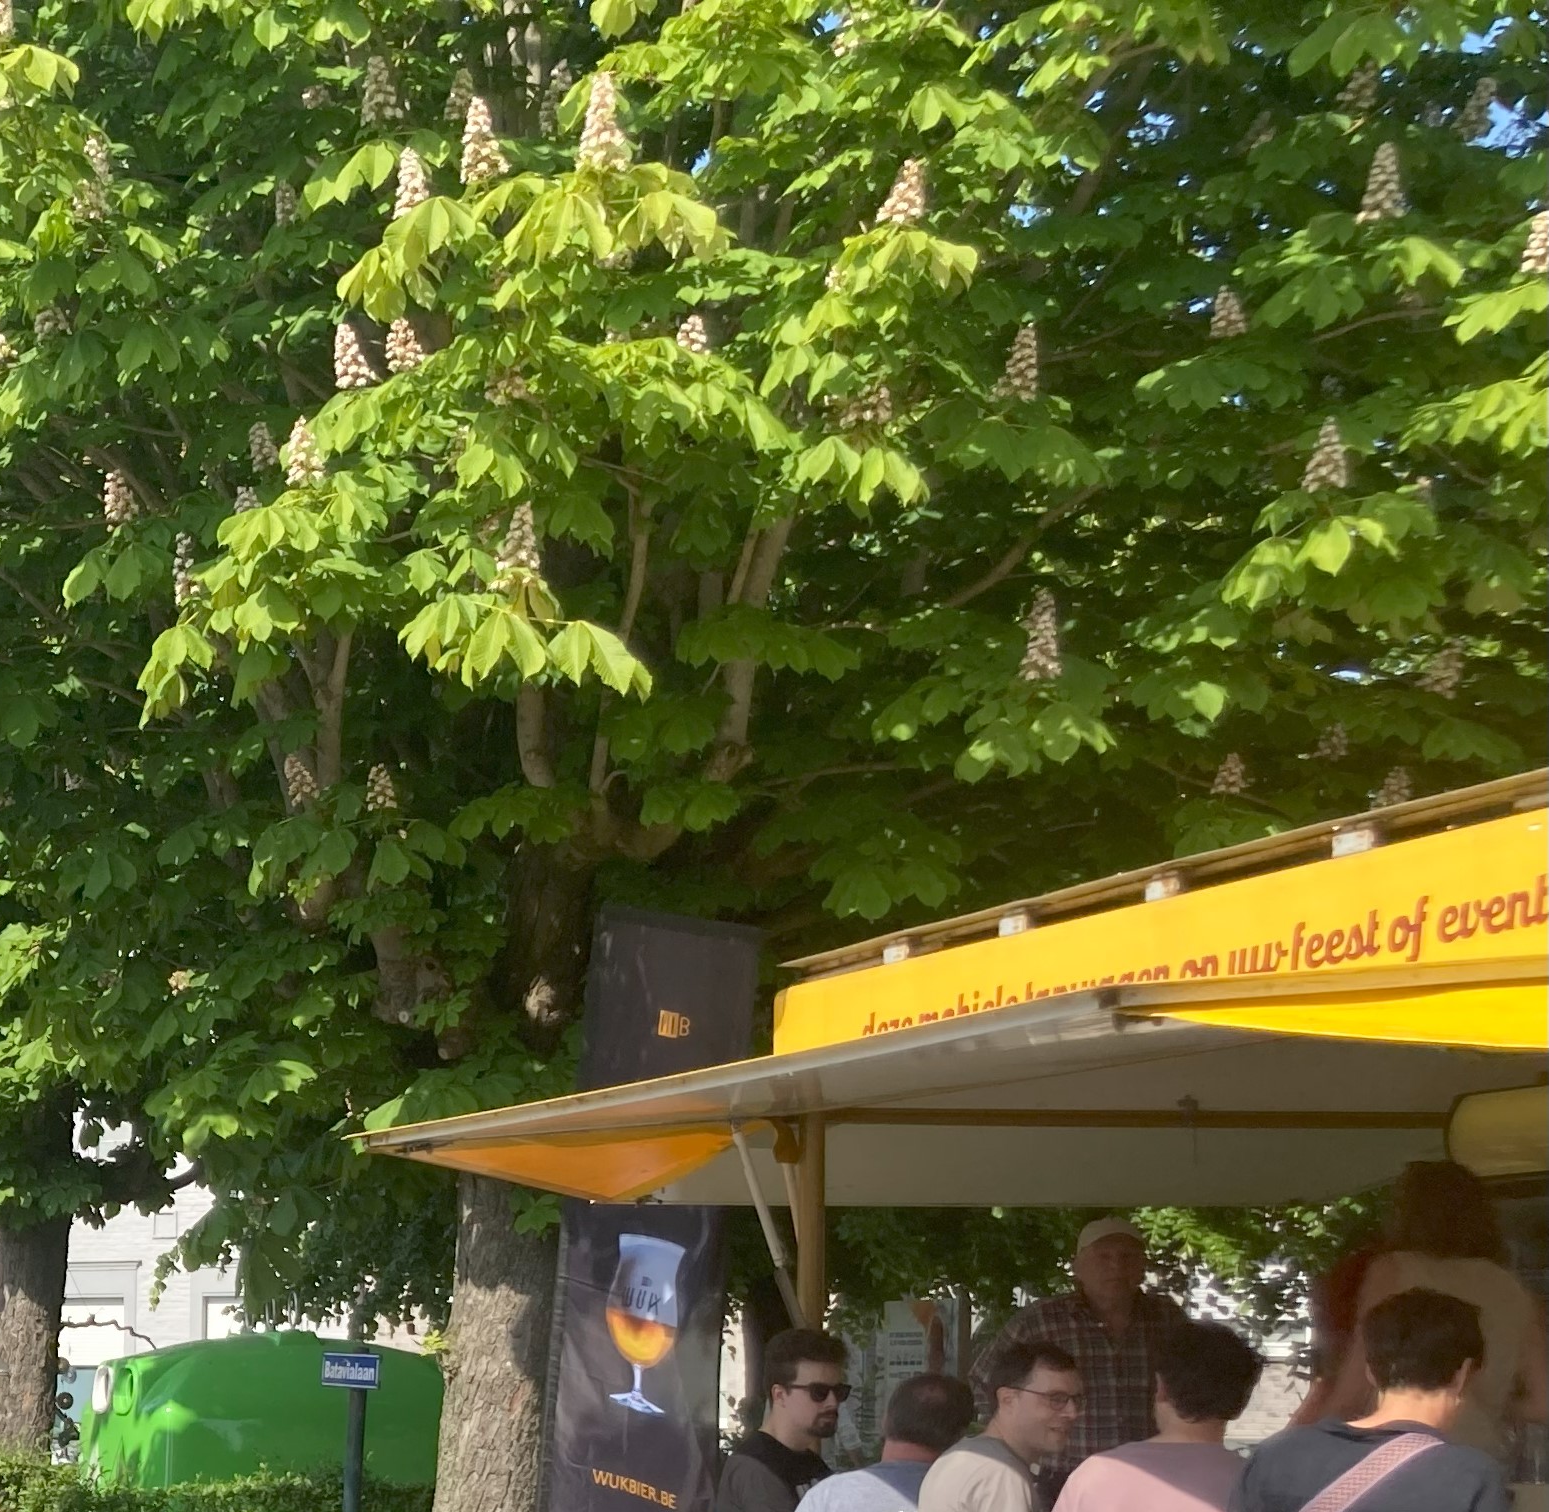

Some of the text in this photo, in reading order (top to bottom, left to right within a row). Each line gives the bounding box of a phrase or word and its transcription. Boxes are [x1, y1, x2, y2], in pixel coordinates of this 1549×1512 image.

[1290, 909, 1381, 970] feest
[1387, 895, 1430, 963] of
[324, 1360, 375, 1381] Batavialaan
[592, 1468, 677, 1510] WUKBIER.BE
